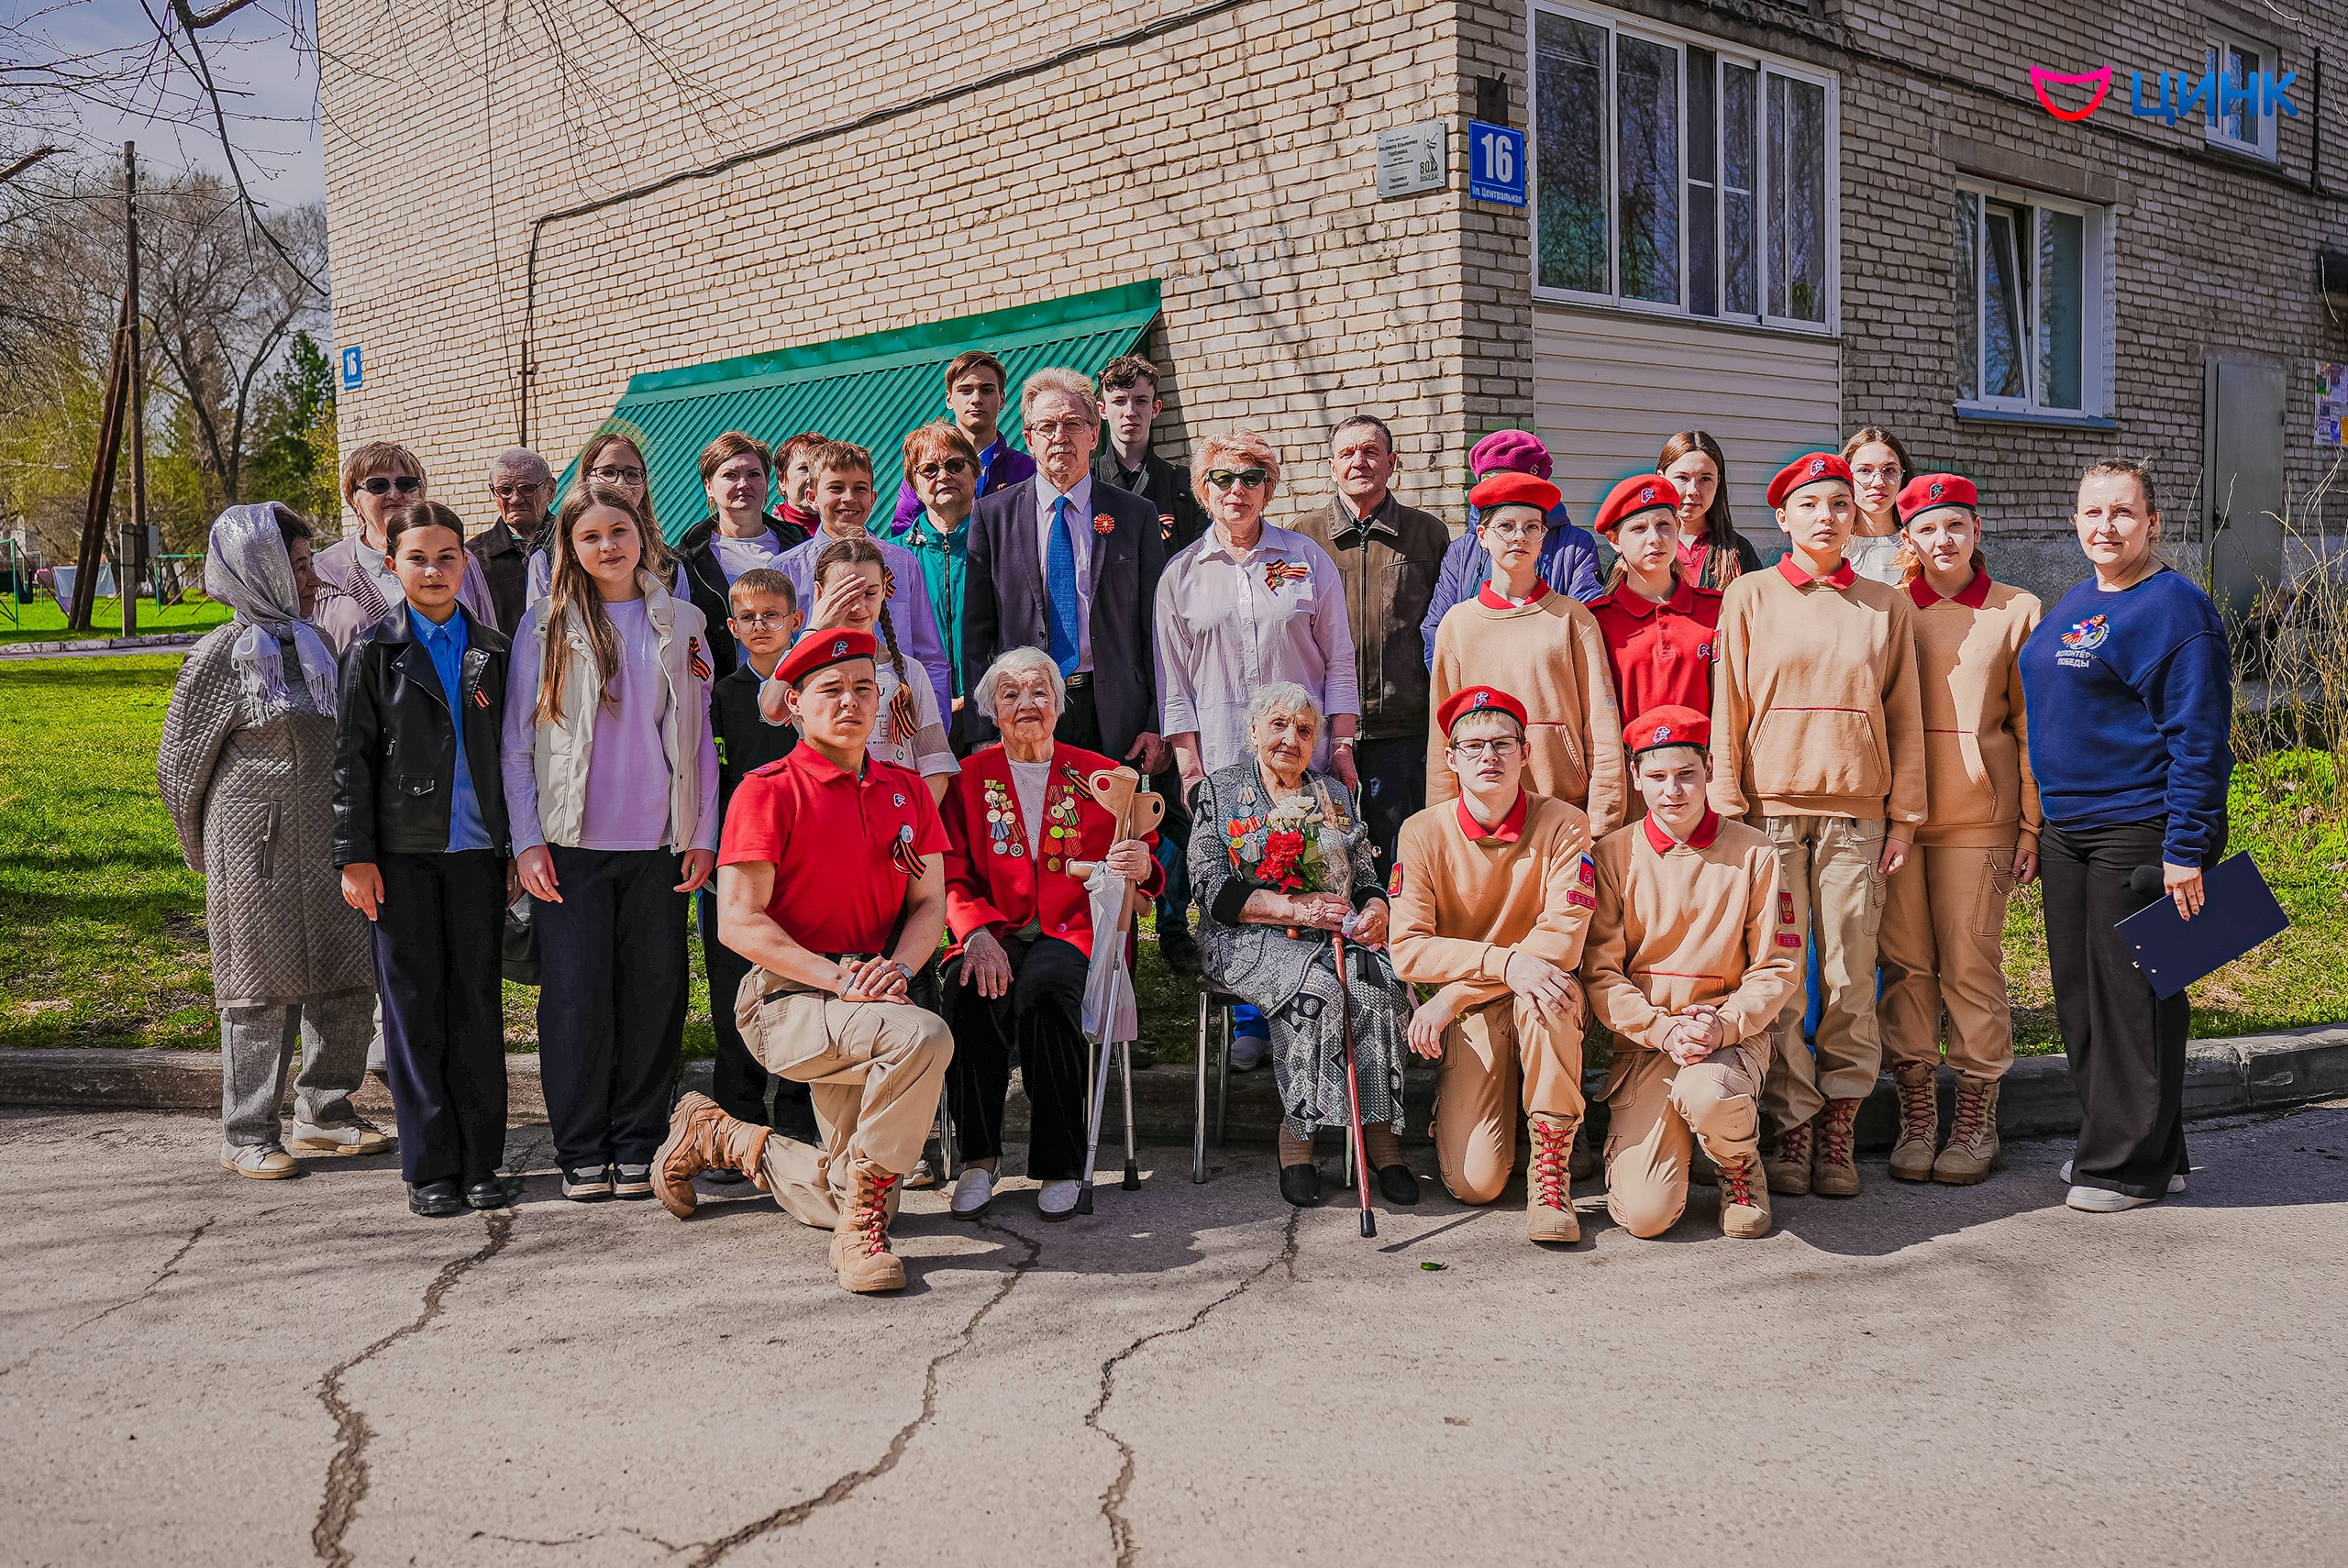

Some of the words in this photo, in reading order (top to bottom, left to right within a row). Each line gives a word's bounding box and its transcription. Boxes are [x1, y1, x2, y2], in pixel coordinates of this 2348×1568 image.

[1420, 160, 1430, 173] 80
[1481, 133, 1513, 182] 16
[1481, 186, 1523, 204] Центральная
[347, 352, 357, 376] 16
[2057, 657, 2089, 668] ПОБЕДЫ
